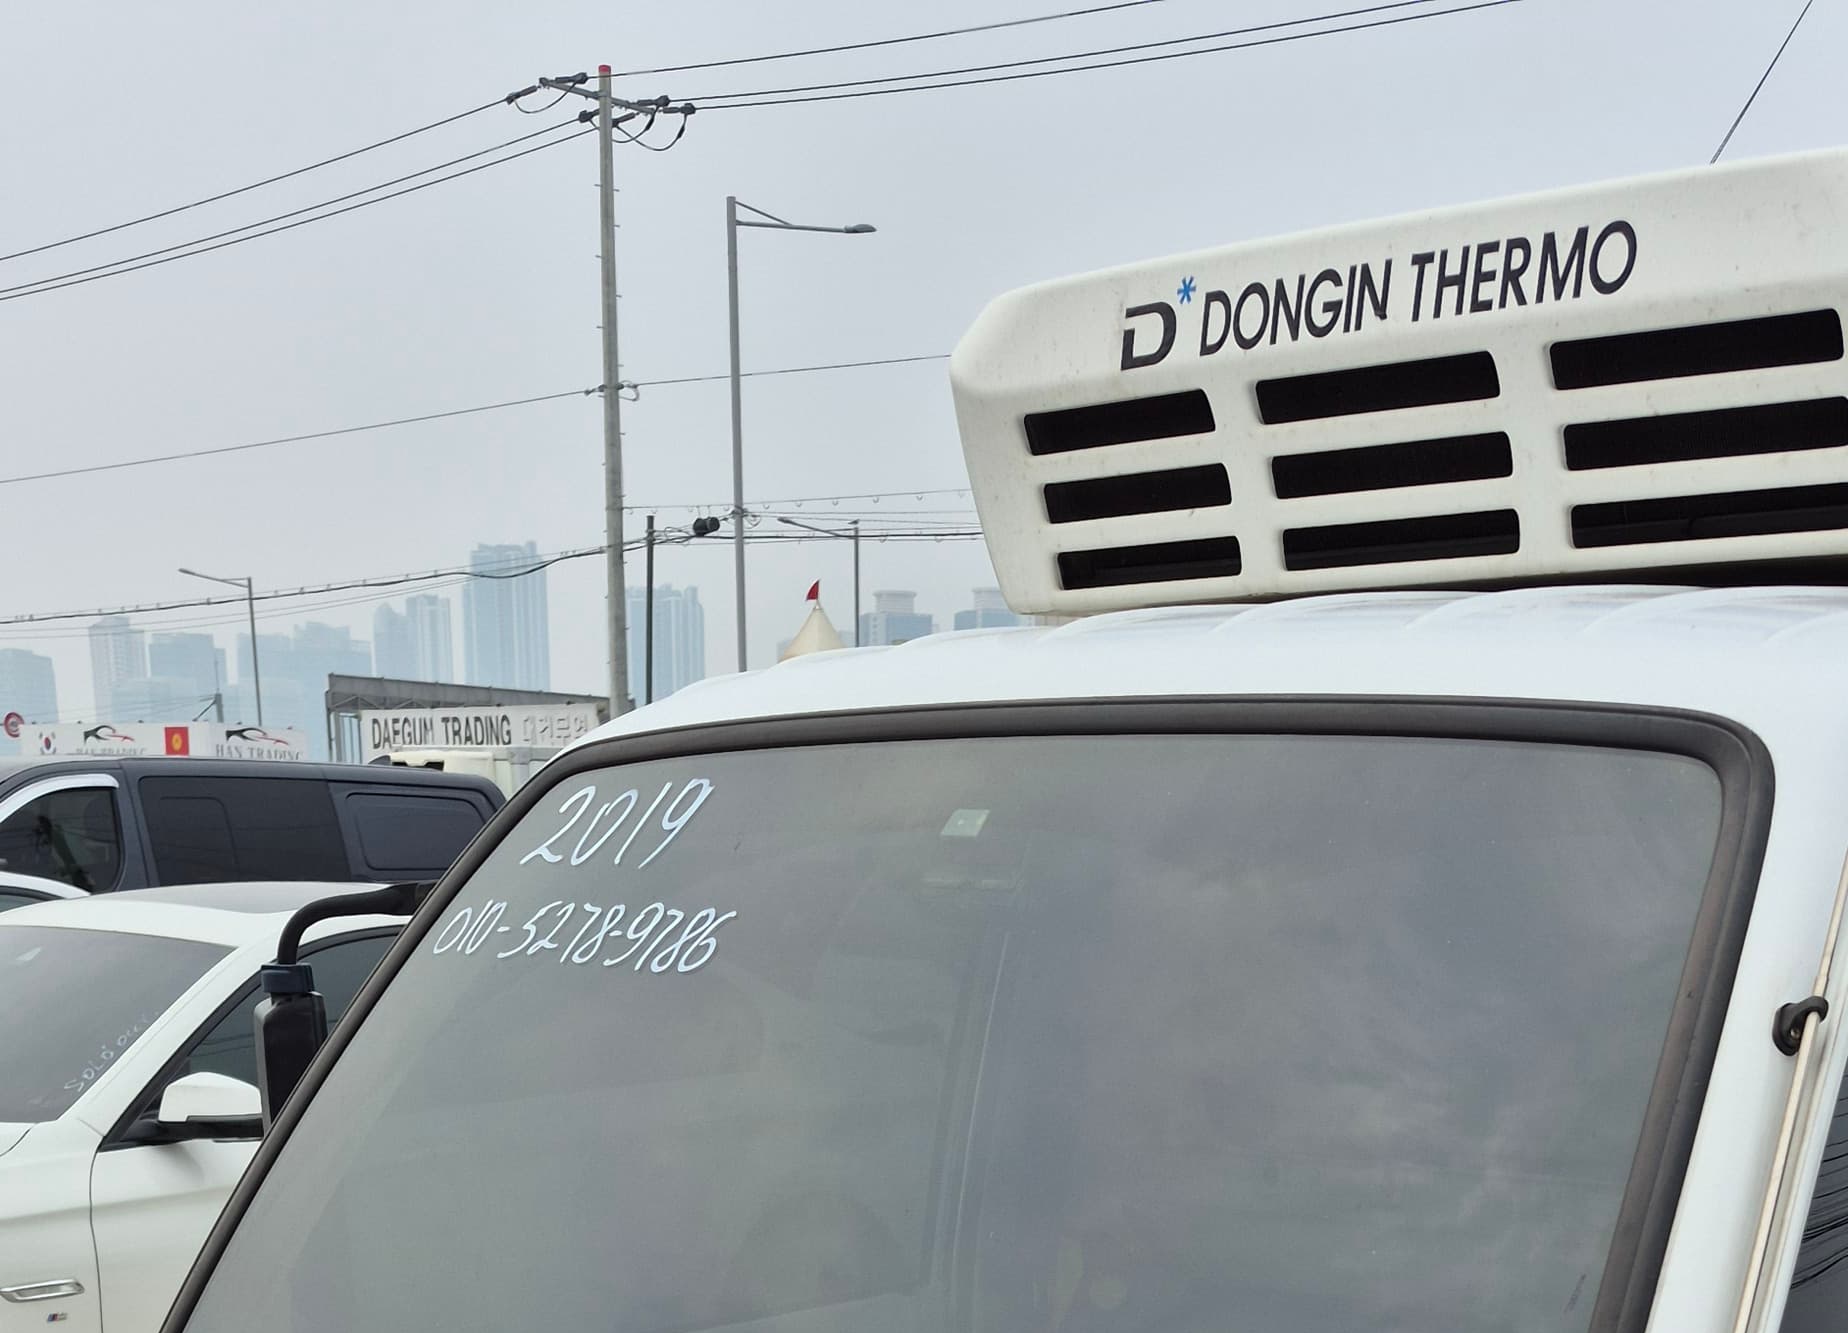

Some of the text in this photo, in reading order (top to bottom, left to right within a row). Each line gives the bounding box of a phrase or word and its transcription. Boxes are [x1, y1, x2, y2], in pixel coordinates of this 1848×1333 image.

[1199, 258, 1392, 357] DONGIN
[1411, 219, 1638, 322] THERMO
[441, 714, 512, 747] TRADING
[519, 778, 715, 869] 2019
[433, 899, 738, 973] 010-5278-9786
